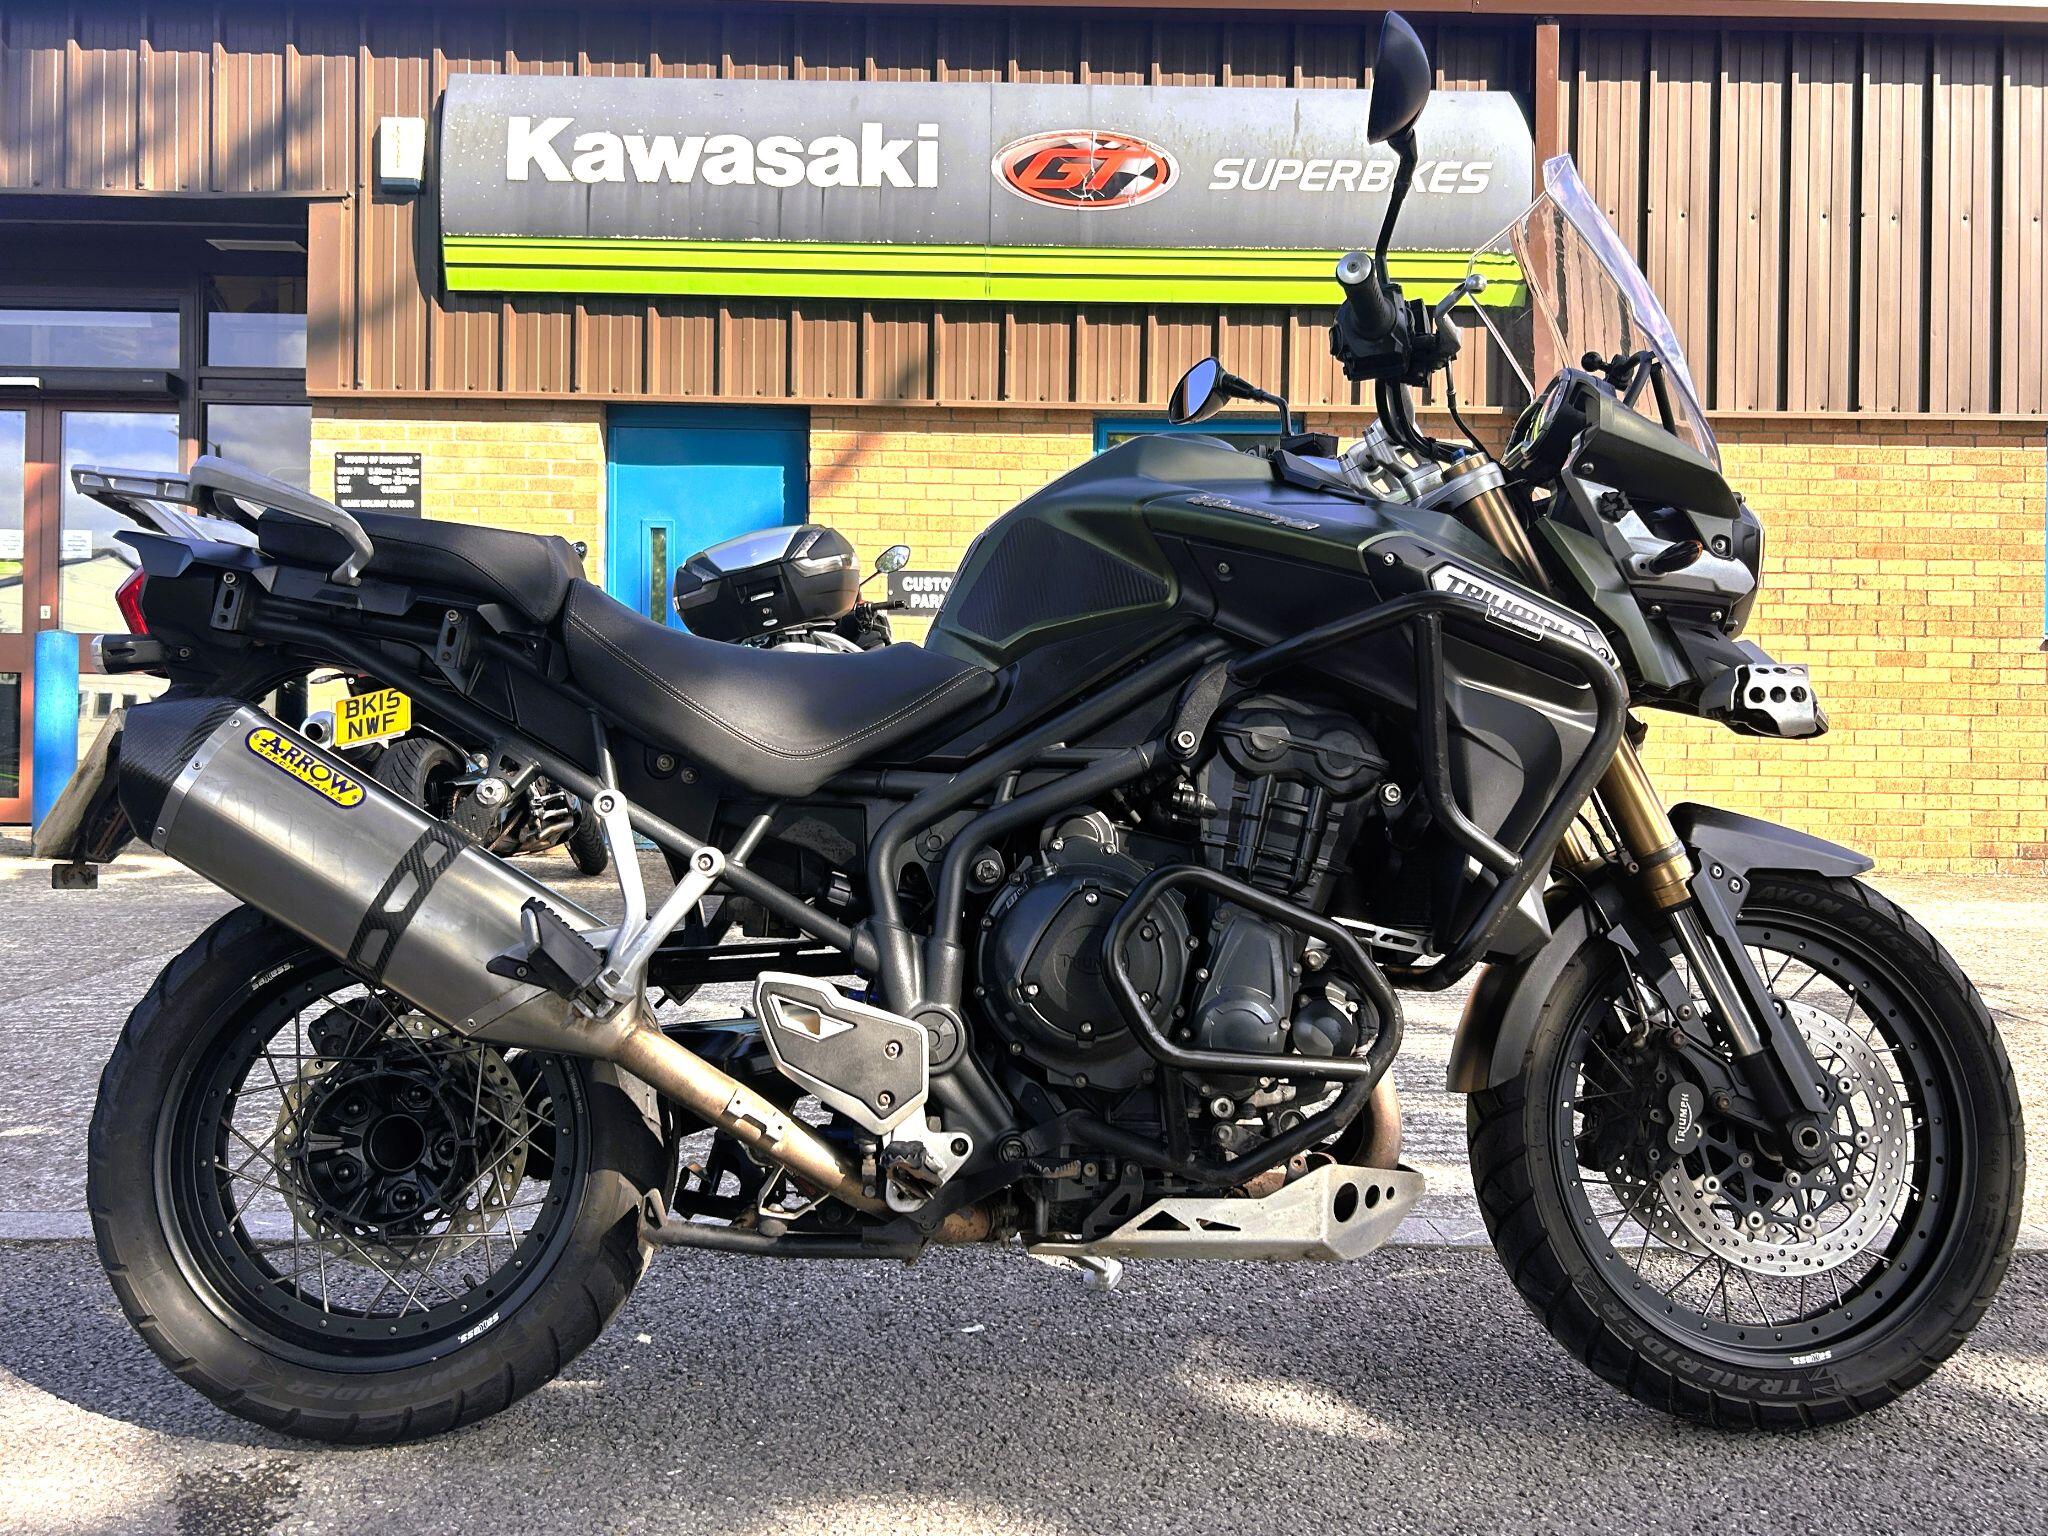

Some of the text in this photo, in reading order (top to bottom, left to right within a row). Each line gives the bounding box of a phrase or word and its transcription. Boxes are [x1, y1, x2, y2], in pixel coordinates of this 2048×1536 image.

[506, 116, 939, 188] Kawasaki
[1017, 148, 1154, 190] GT
[1208, 157, 1493, 194] SUPERBKES
[345, 689, 401, 719] BK15
[348, 711, 398, 740] NWF
[257, 746, 343, 802] SPECIAL PARTS
[259, 736, 358, 795] ARROW
[1752, 886, 1844, 914] AVON
[1674, 1093, 1690, 1145] TRIUMPH
